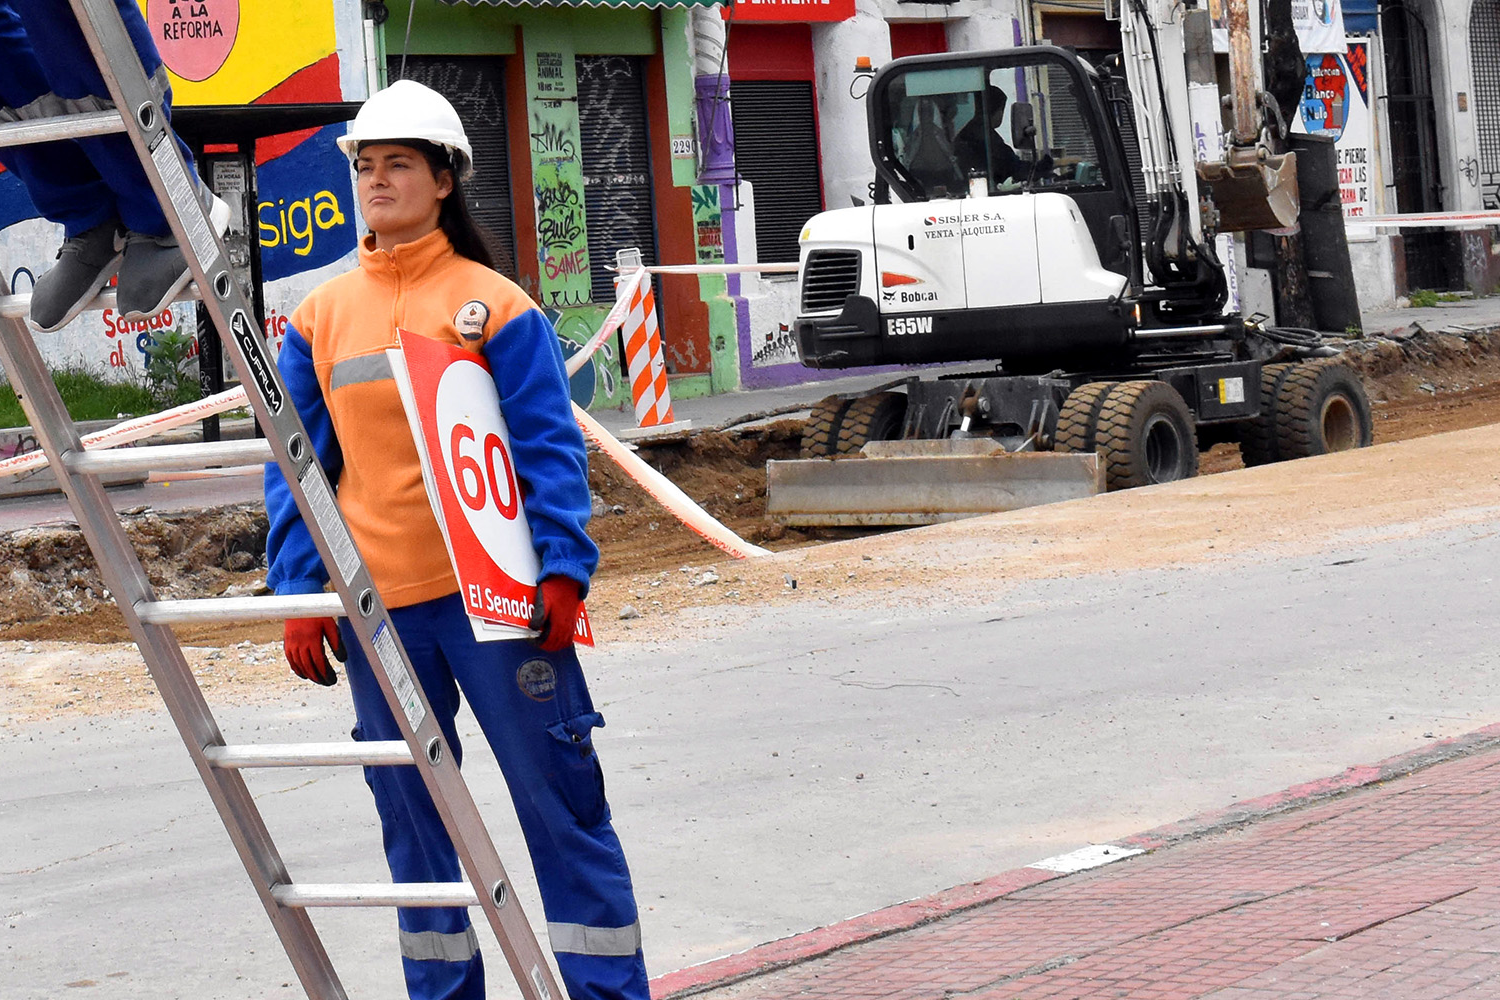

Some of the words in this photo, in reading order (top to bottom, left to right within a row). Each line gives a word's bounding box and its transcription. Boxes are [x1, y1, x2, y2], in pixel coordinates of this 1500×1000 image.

[172, 6, 182, 19] A
[191, 4, 208, 18] LA
[163, 20, 223, 40] REFORMA
[938, 214, 979, 225] SISLER
[925, 229, 954, 239] VENTA
[961, 225, 1005, 237] ALQUILER
[887, 316, 932, 336] E55W
[244, 336, 279, 409] CUPRUM
[451, 423, 518, 520] 60
[468, 583, 482, 609] El
